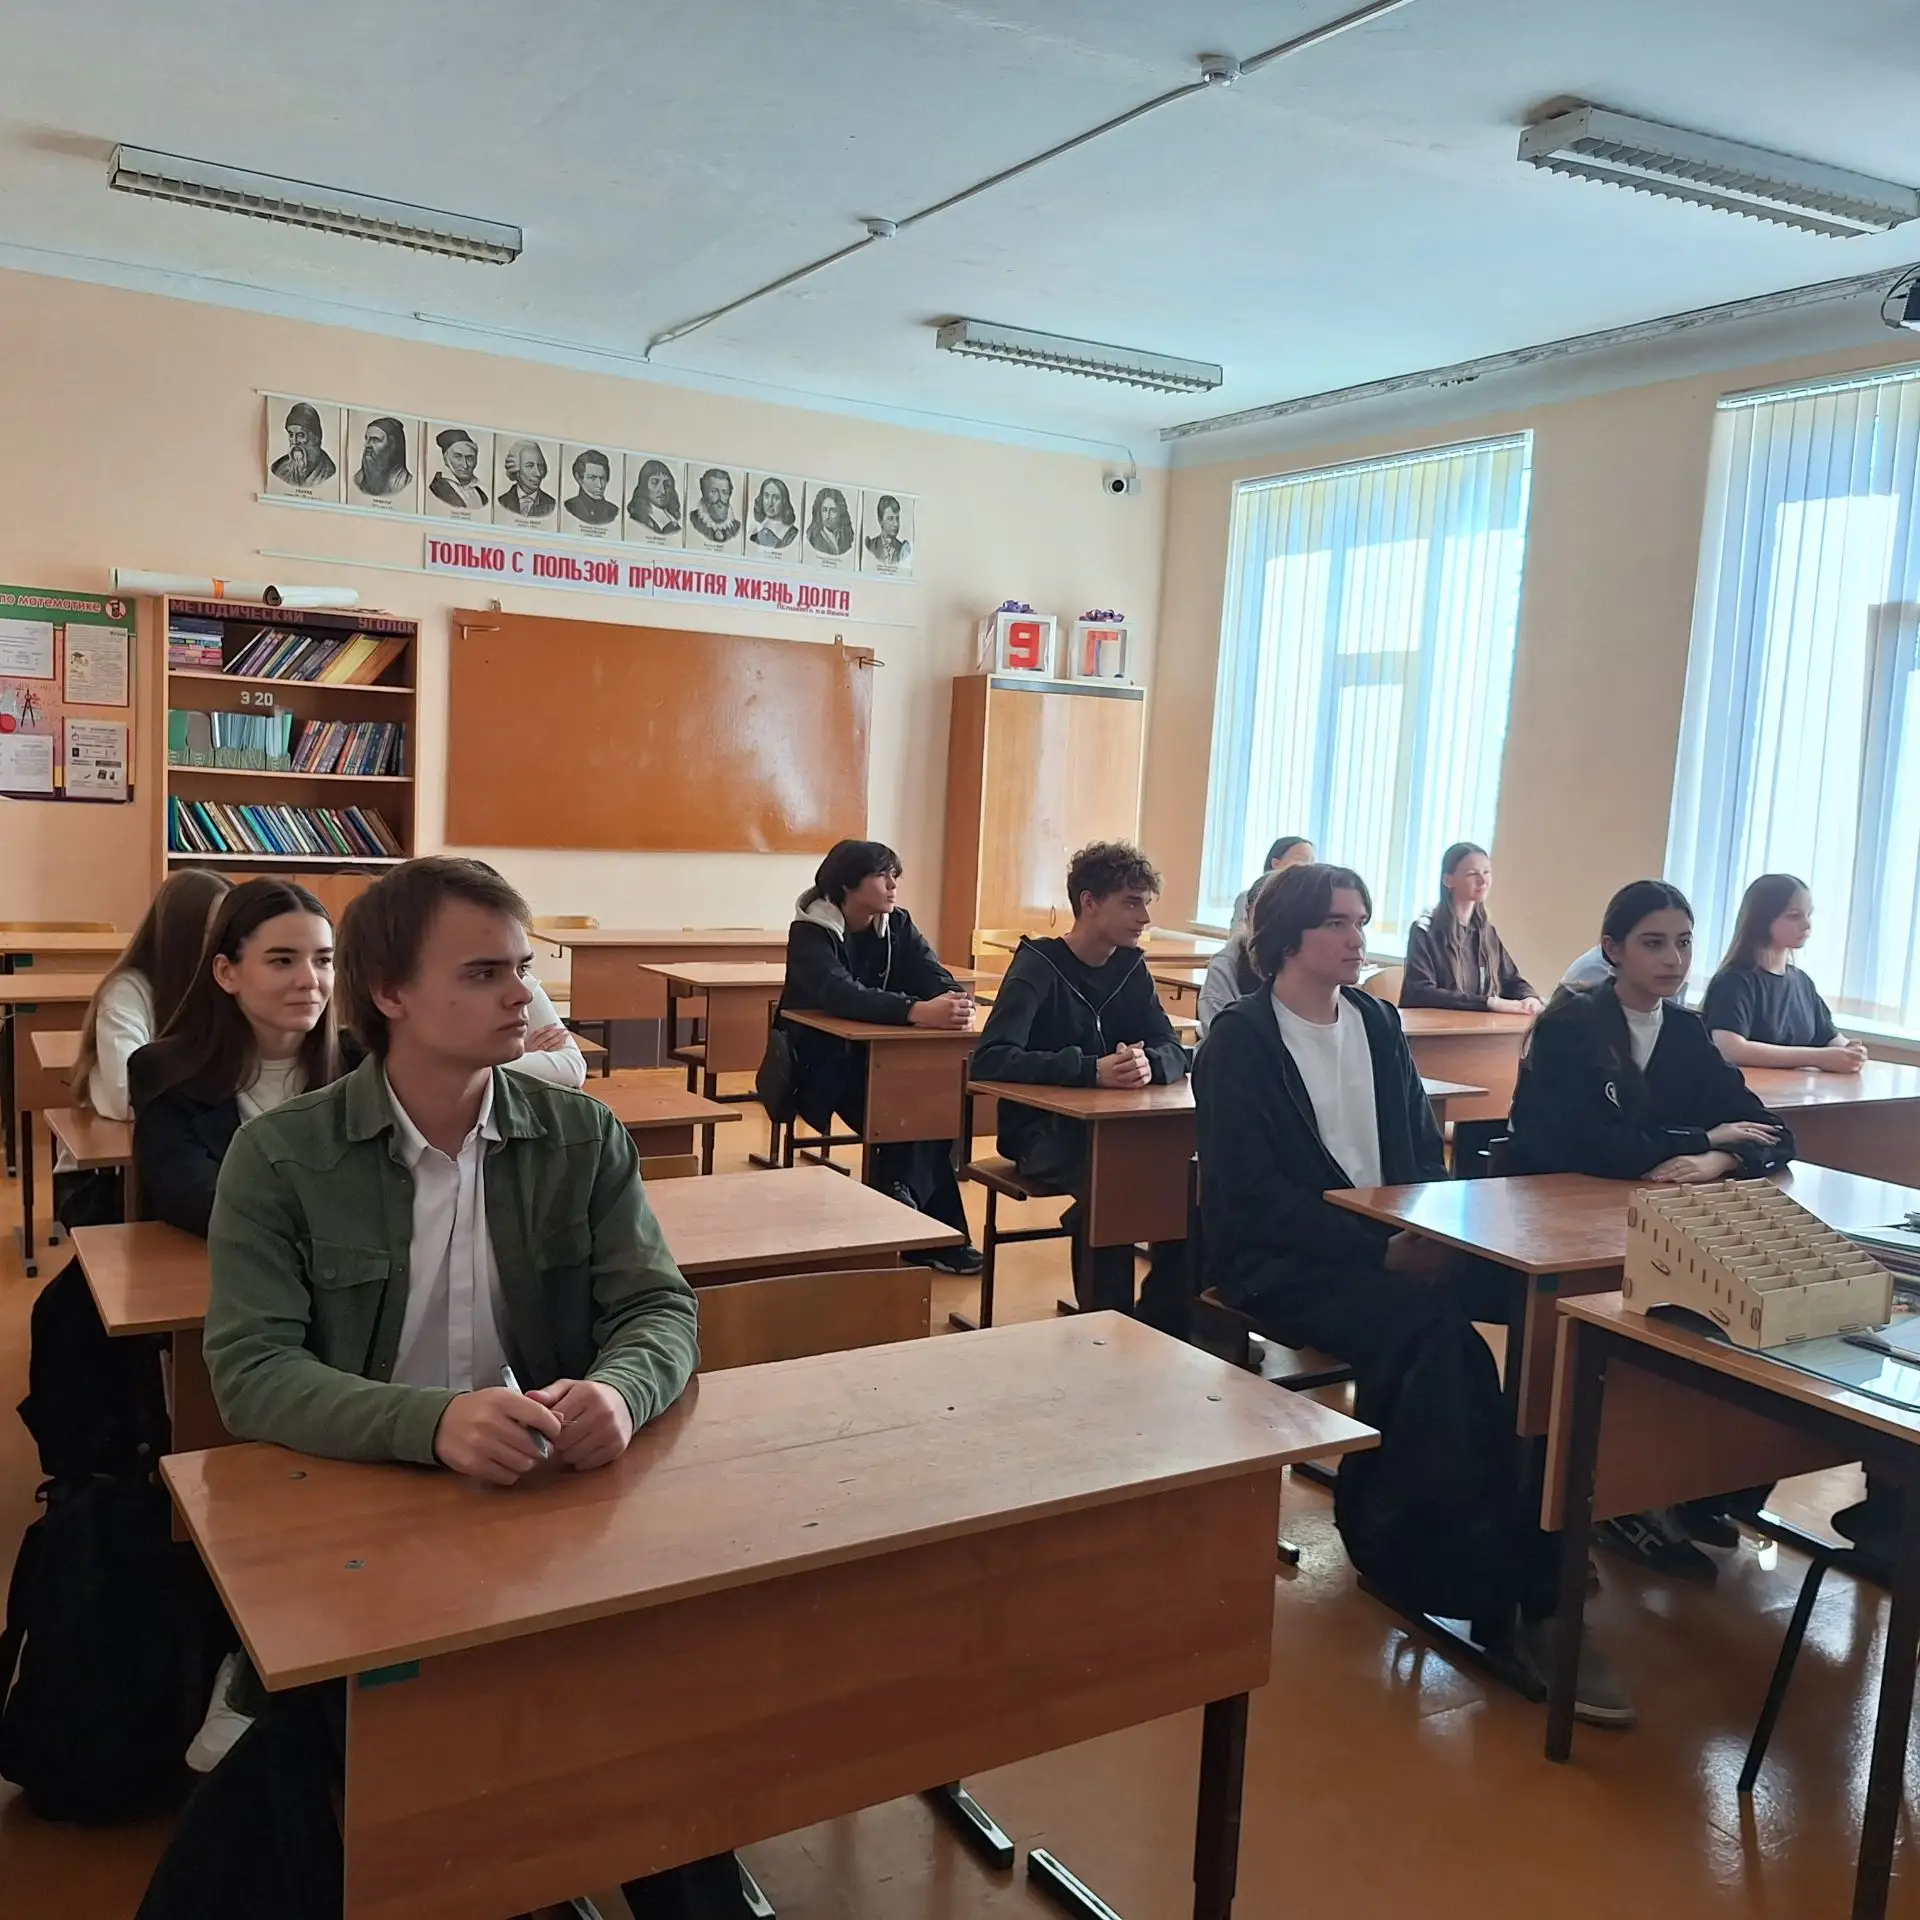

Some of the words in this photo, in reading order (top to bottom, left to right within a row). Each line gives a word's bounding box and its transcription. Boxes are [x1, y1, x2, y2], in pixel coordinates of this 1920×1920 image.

[428, 540, 505, 571] ТОЛЬКО
[512, 551, 524, 573] С
[533, 553, 619, 586] ПОЛЬЗОЙ
[628, 566, 727, 596] ПРОЖИТАЯ
[734, 577, 793, 605] ЖИЗНЬ
[797, 585, 850, 611] ДОЛГА
[18, 596, 101, 613] математике
[359, 617, 416, 634] УГОЛОК
[1009, 622, 1040, 668] 9
[254, 691, 274, 706] 20
